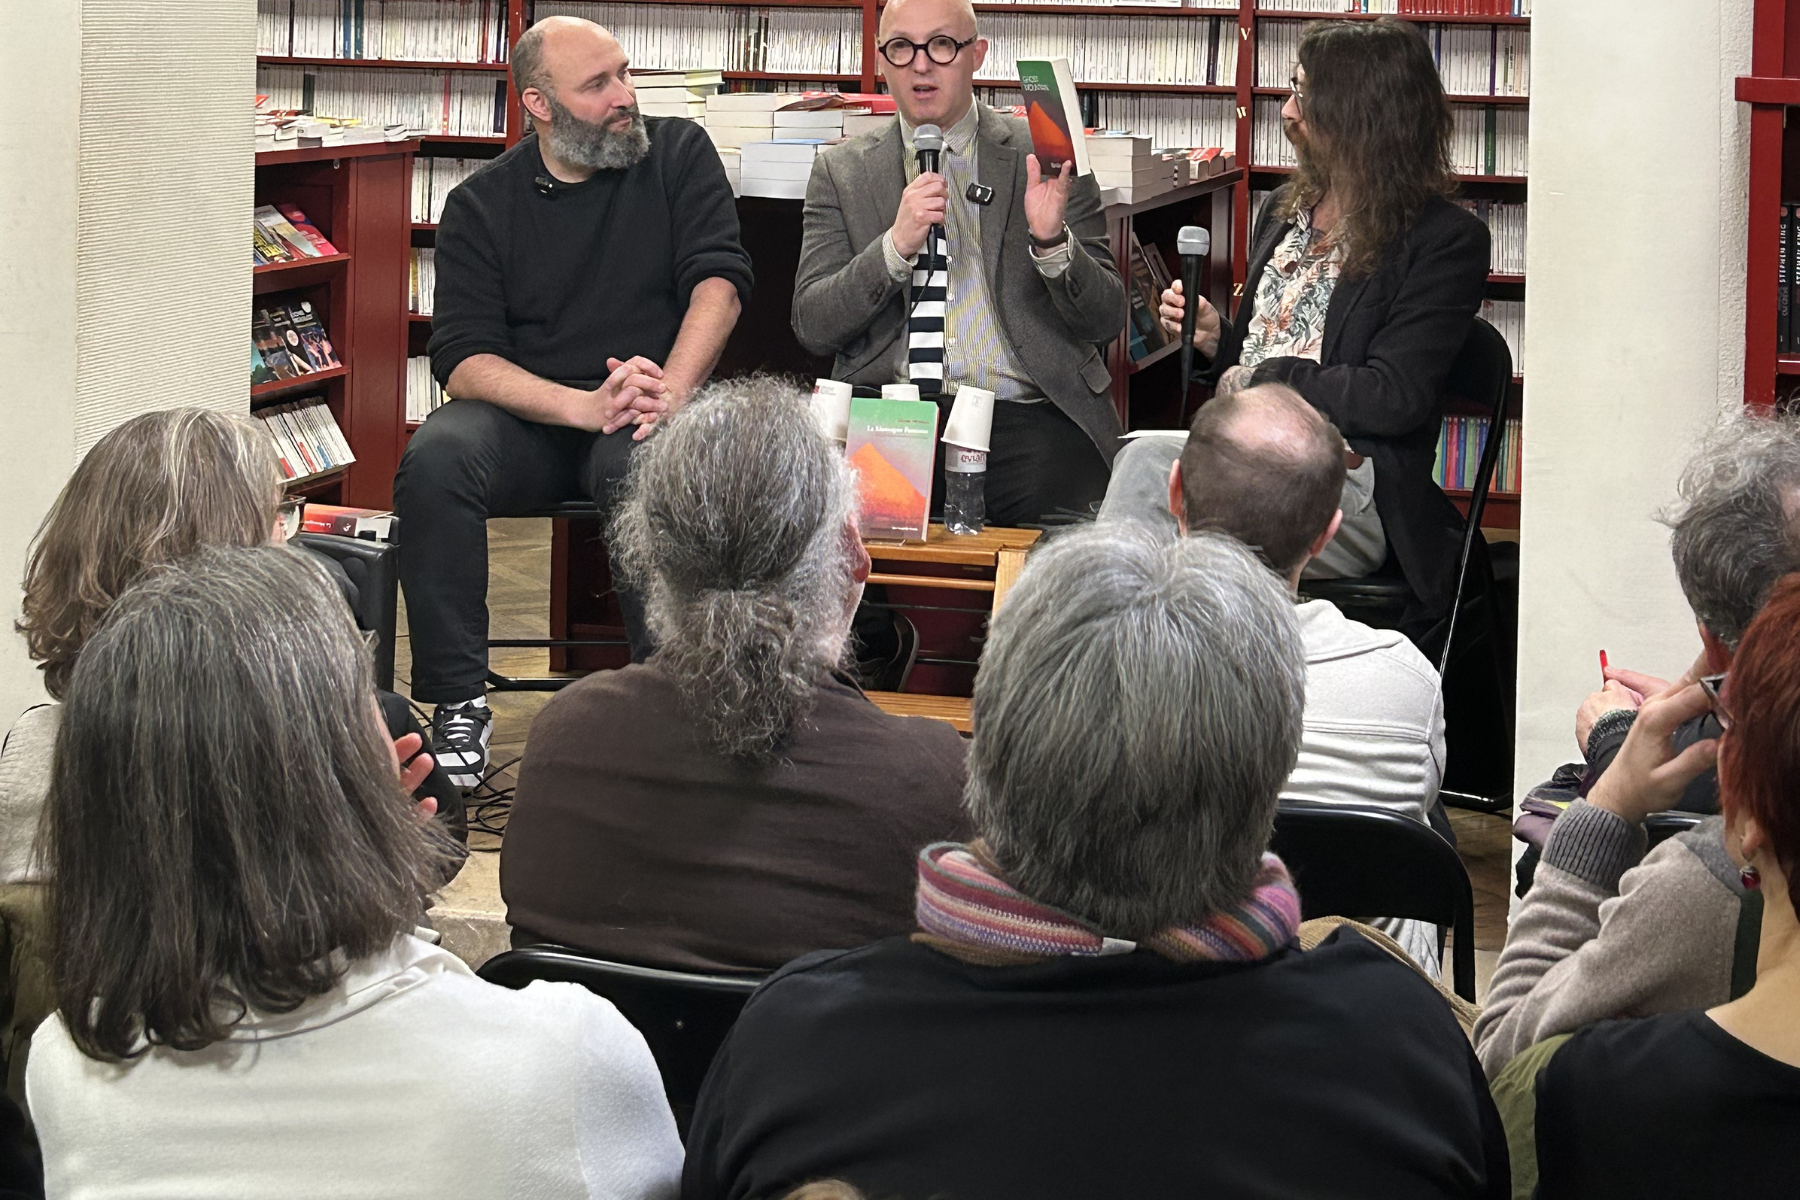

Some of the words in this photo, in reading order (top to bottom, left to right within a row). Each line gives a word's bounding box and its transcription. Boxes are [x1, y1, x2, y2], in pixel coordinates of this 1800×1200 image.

[1240, 27, 1251, 40] V
[1233, 282, 1243, 297] Z
[960, 454, 986, 463] evian
